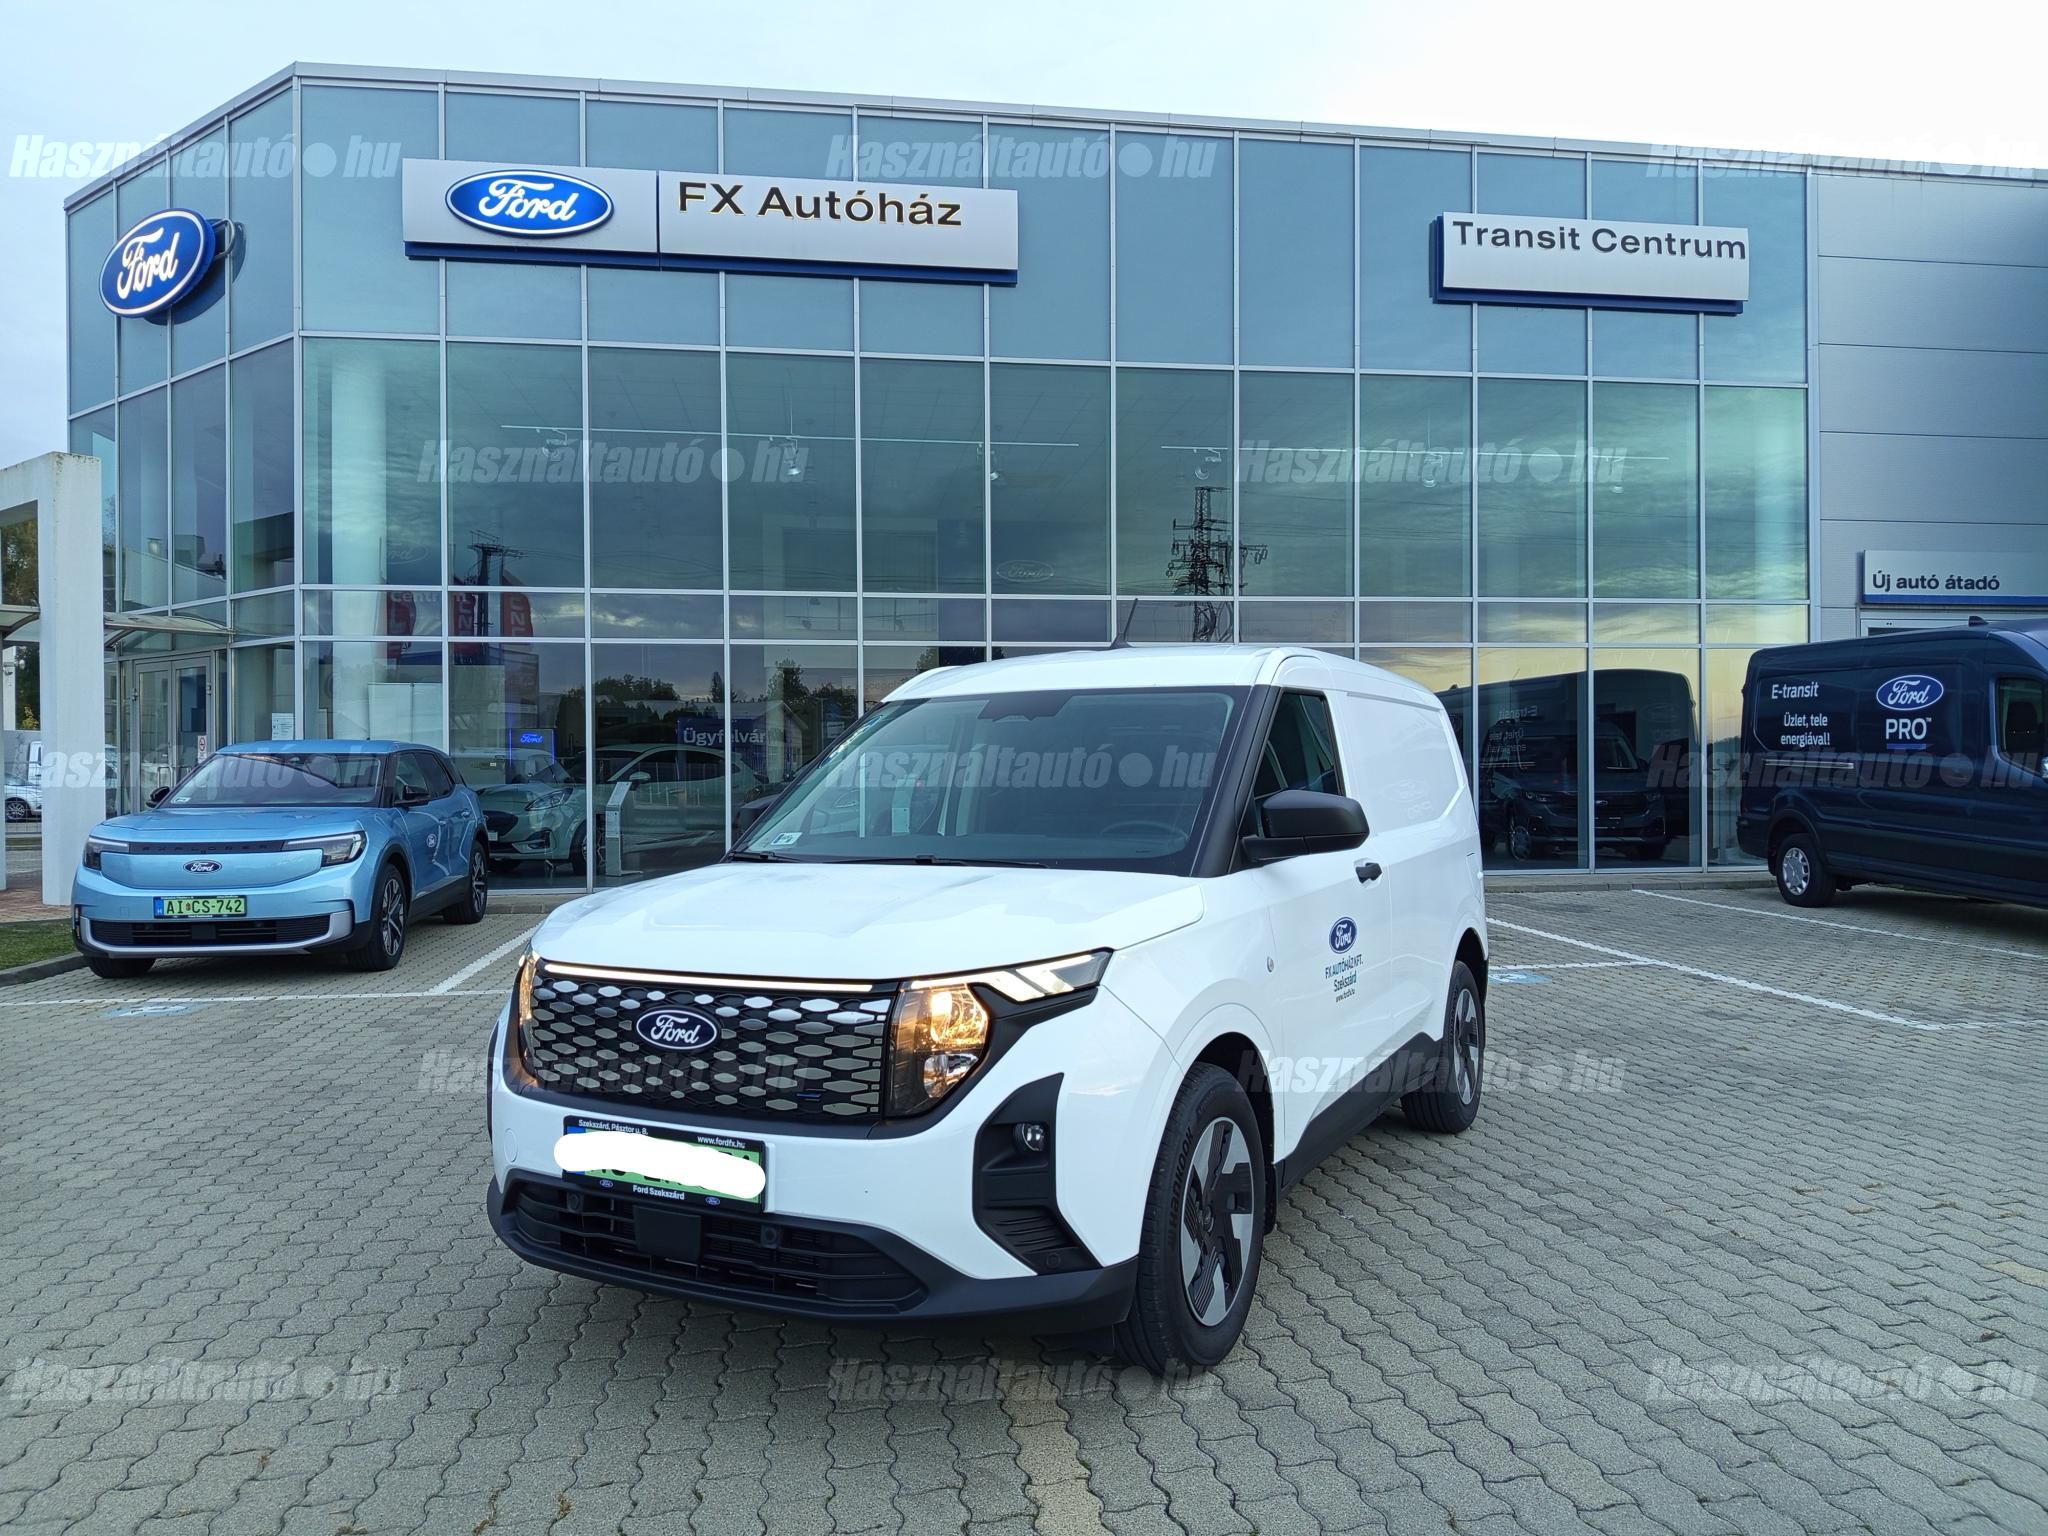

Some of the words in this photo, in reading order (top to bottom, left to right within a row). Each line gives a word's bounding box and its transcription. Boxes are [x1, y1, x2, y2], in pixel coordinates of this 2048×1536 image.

[478, 178, 580, 222] Ford
[679, 181, 745, 216] FX
[757, 185, 962, 226] Autóház
[1452, 220, 1580, 251] Transit
[1592, 228, 1746, 260] Centrum
[117, 227, 180, 299] Ford
[1872, 570, 1891, 592] Új
[1896, 574, 1940, 590] autó
[1945, 574, 2001, 590] átadó
[1771, 682, 1819, 699] E-transit
[1810, 713, 1828, 727] tele
[520, 733, 544, 743] Ford
[1781, 732, 1830, 748] energiával!
[632, 1185, 649, 1196] Ford
[650, 1187, 685, 1200] Szekszárd
